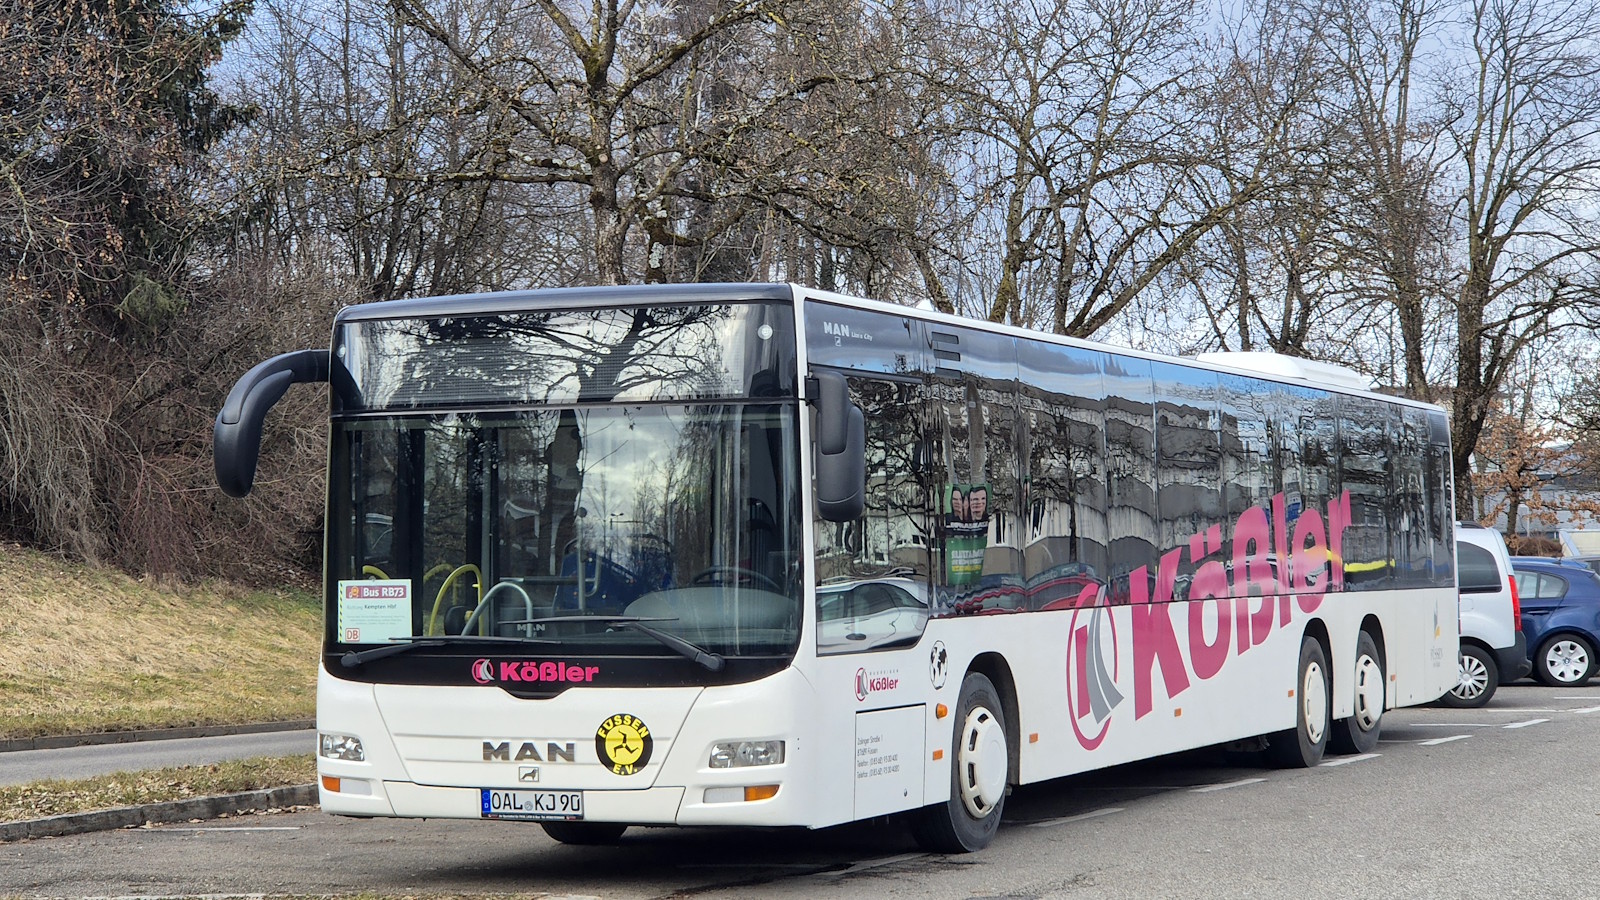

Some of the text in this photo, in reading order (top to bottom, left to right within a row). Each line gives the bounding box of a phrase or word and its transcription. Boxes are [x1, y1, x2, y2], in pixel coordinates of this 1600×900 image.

[823, 321, 850, 337] MAN
[863, 333, 873, 341] City
[363, 587, 404, 597] Bus RB73
[1129, 489, 1352, 721] Kößler
[346, 629, 359, 640] DB
[500, 661, 599, 682] Kößler
[869, 676, 899, 692] Kößler
[482, 741, 575, 762] MAN
[613, 763, 638, 775] E.V.
[491, 792, 523, 810] OAL
[534, 793, 556, 811] KJ
[560, 794, 581, 811] 90
